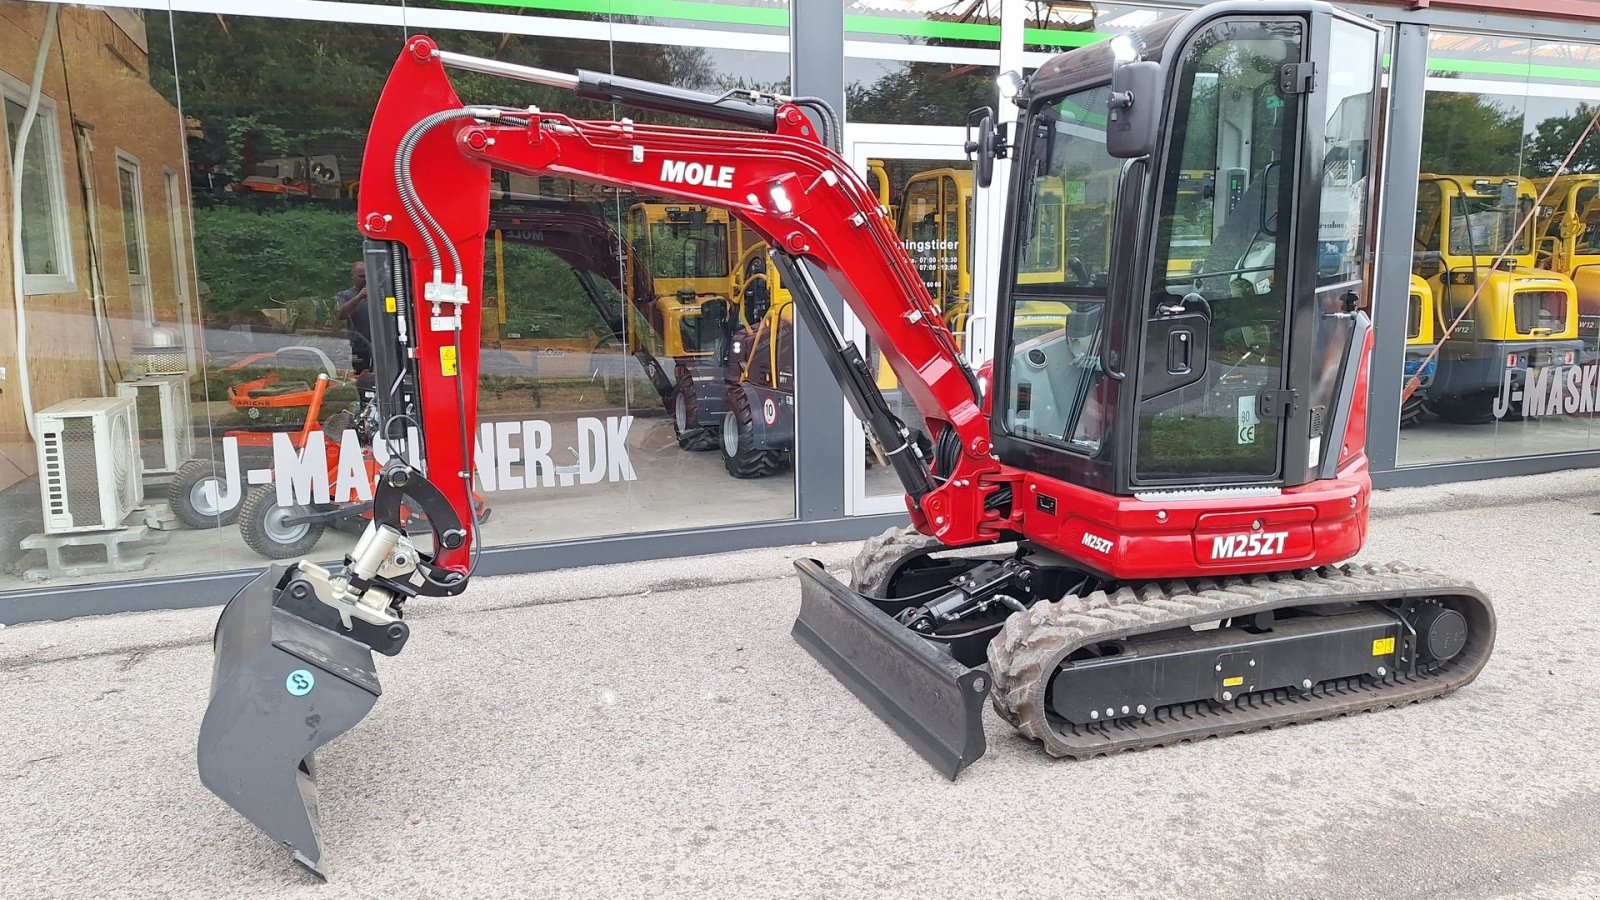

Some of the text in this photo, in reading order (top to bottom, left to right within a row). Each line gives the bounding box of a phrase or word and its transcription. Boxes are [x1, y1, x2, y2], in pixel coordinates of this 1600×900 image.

[660, 159, 735, 189] MOLE
[1579, 321, 1595, 329] W12
[765, 403, 773, 414] 10
[1239, 426, 1254, 442] CE
[206, 415, 638, 514] J-MASNER.DK
[1081, 532, 1114, 554] M25ZT
[1211, 531, 1289, 560] M25ZT
